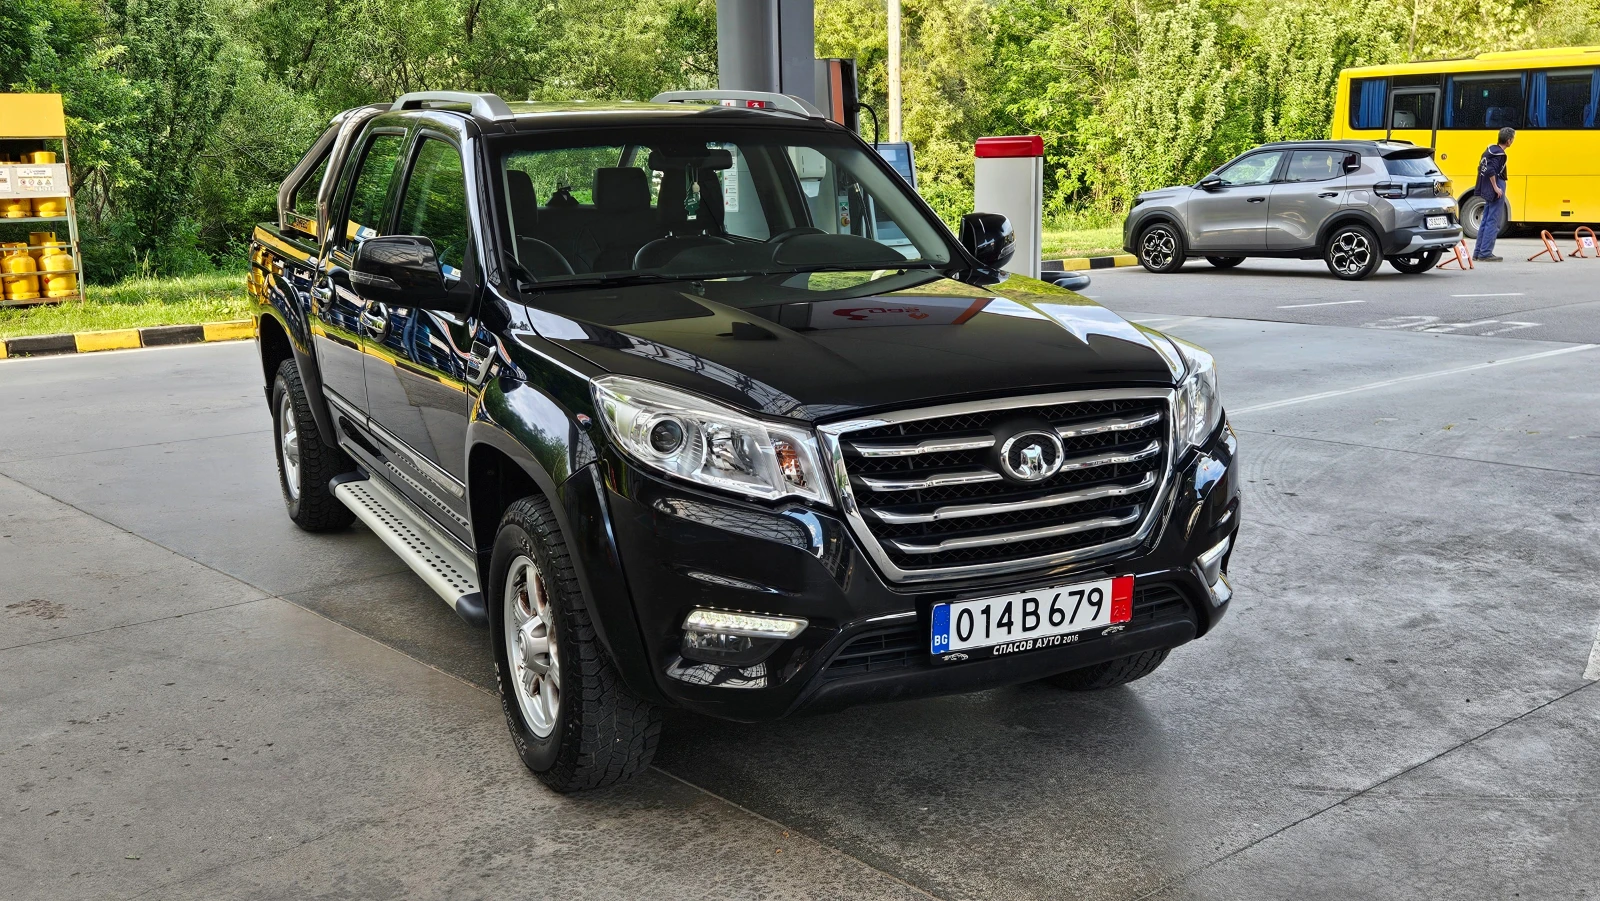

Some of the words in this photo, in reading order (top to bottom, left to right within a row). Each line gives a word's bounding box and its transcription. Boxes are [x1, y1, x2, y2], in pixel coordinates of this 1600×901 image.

[934, 634, 948, 646] BG
[993, 639, 1033, 655] СПАСОВ
[1035, 635, 1061, 648] АУТО
[1063, 634, 1078, 643] 2016
